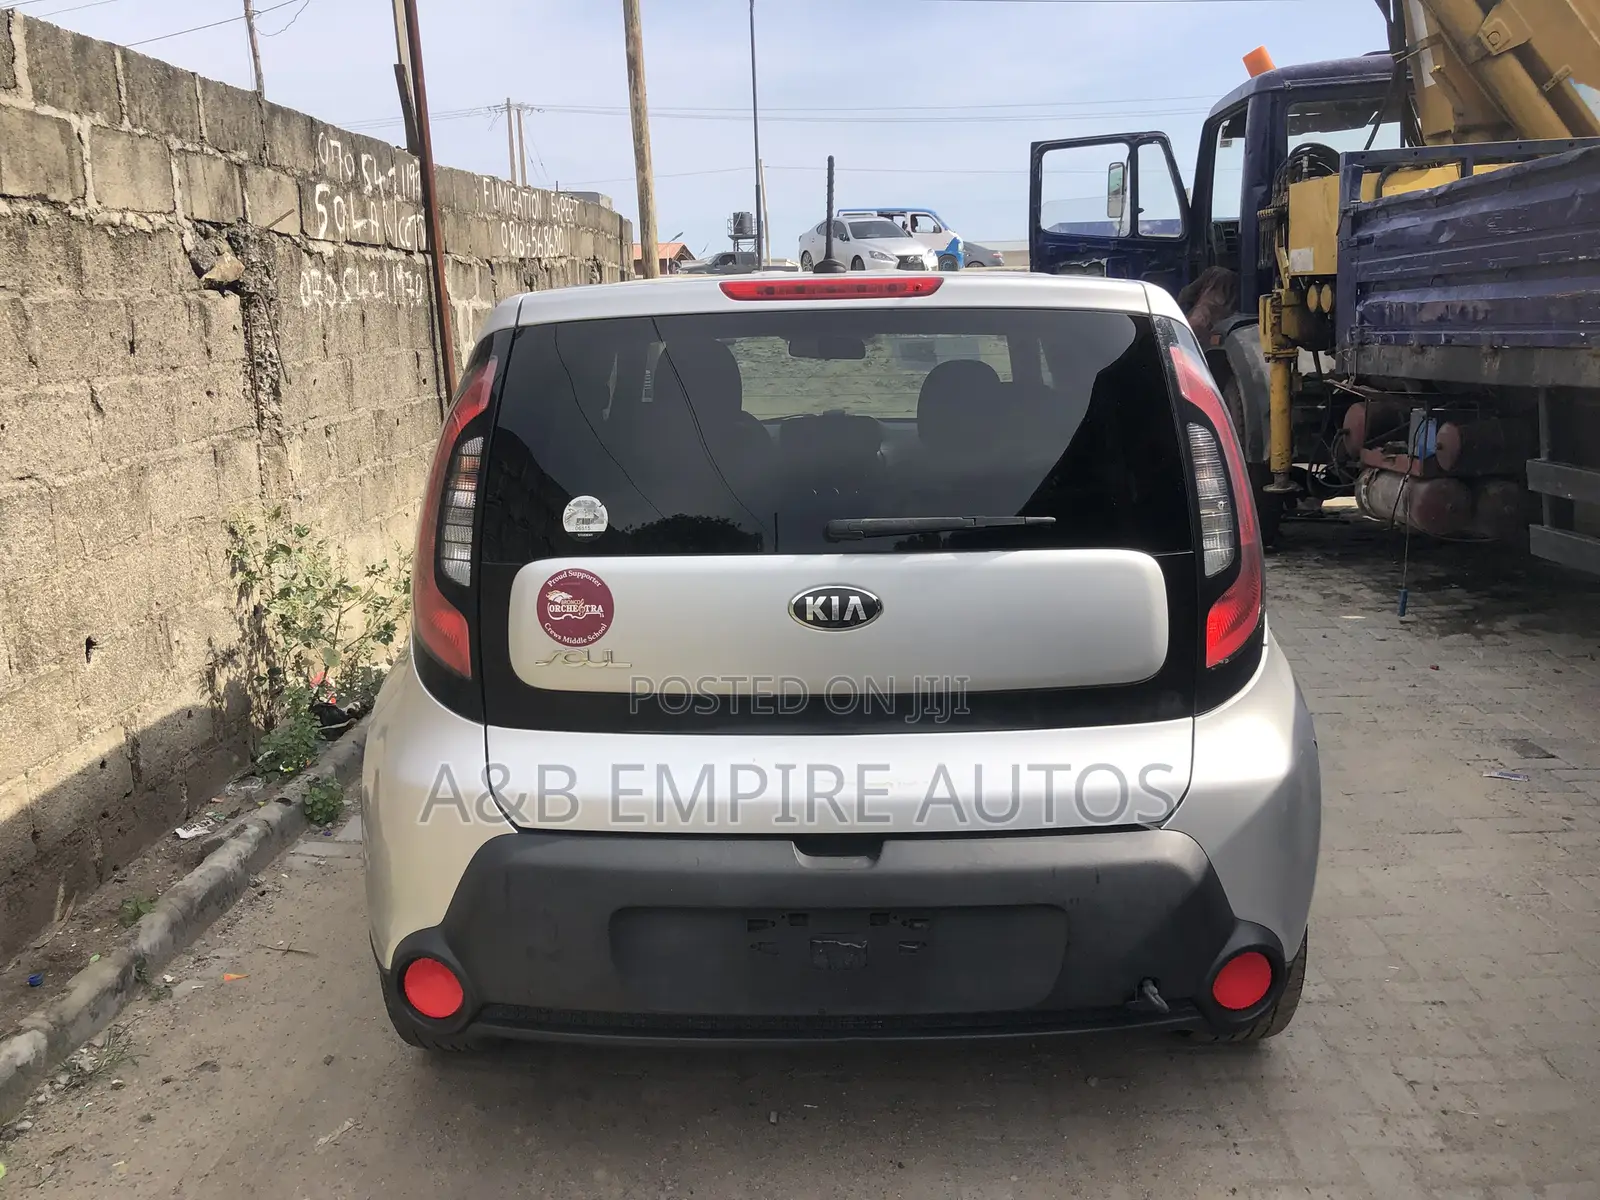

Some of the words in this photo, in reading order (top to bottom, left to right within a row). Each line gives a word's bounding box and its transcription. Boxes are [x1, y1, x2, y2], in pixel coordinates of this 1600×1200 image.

[482, 177, 542, 220] FUMIGATION
[550, 192, 580, 223] EXPERT
[547, 570, 568, 588] Proud
[568, 569, 602, 588] Supporter
[804, 595, 868, 622] KIA
[544, 622, 562, 640] Crews
[562, 635, 588, 645] Middle
[587, 622, 608, 642] School
